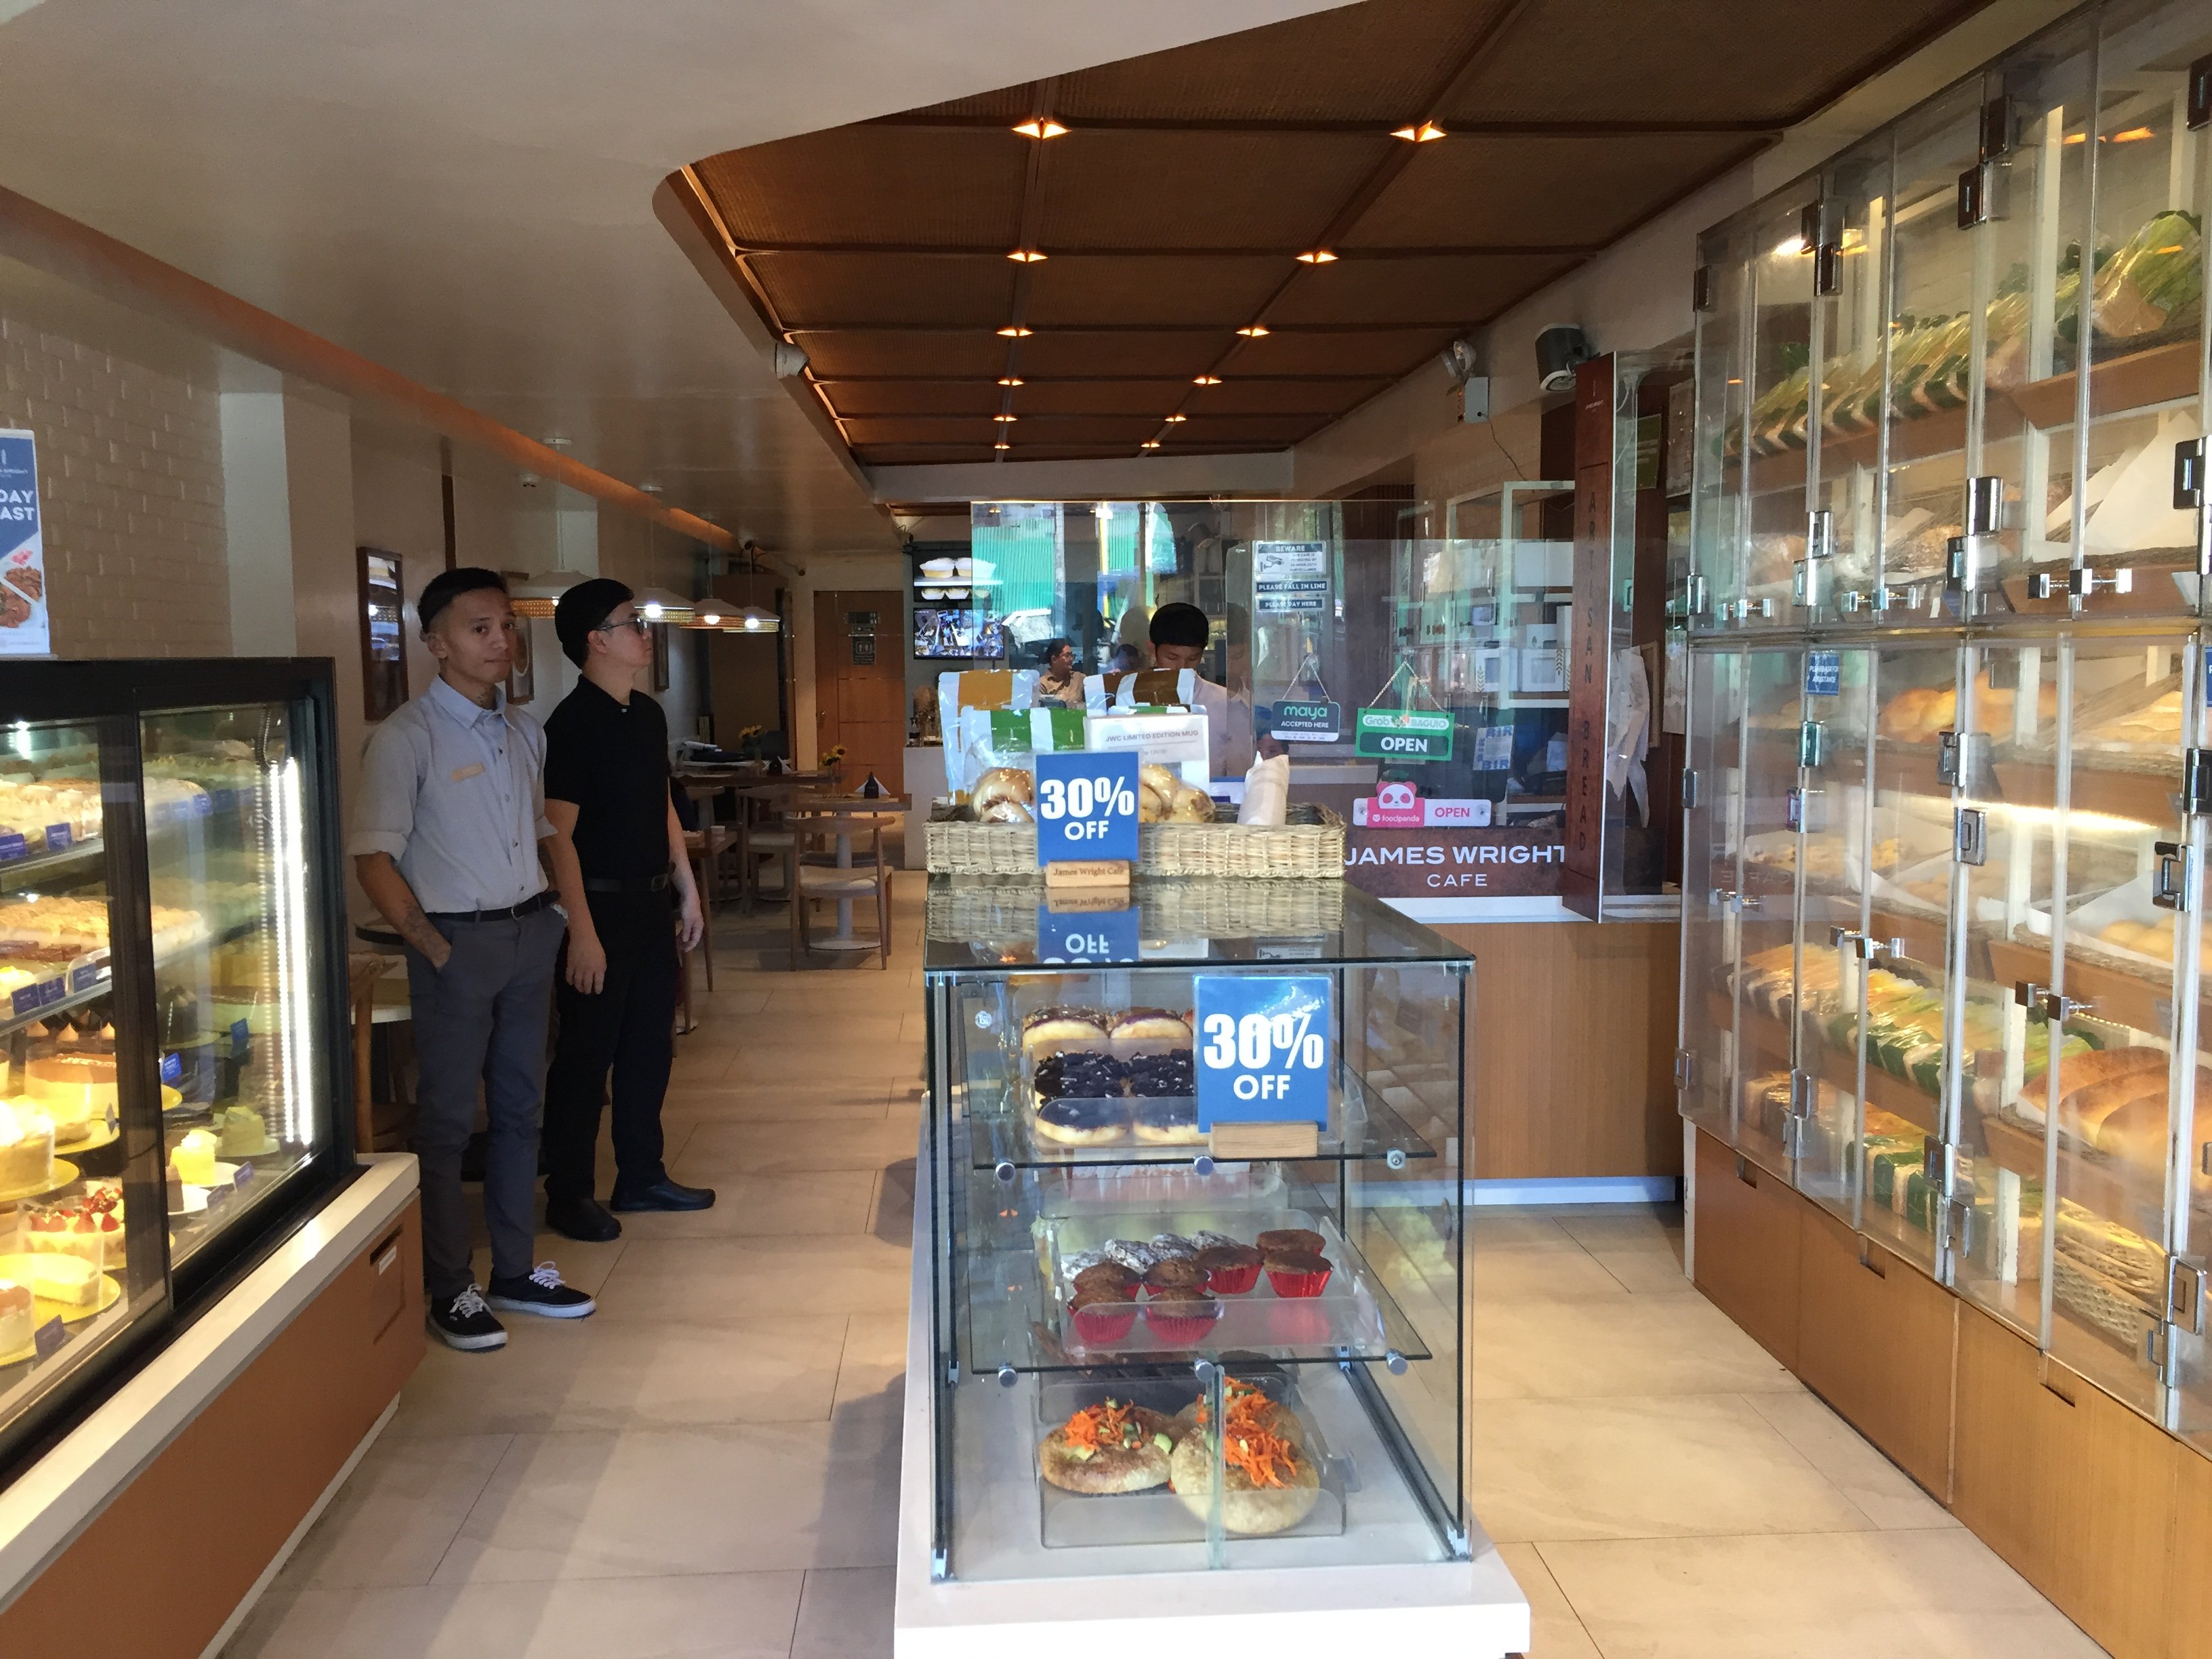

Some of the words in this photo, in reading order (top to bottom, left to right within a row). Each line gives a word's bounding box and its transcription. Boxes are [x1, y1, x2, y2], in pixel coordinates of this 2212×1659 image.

[1284, 705, 1328, 720] maya
[1365, 716, 1390, 726] Grab
[1411, 720, 1446, 729] BAGUIO
[1380, 736, 1428, 752] OPEN
[1040, 776, 1135, 819] 30%
[1382, 814, 1420, 823] foodpanda
[1434, 807, 1470, 818] OPEN
[1064, 820, 1109, 840] OFF
[1345, 846, 1446, 865] JAMES
[1452, 845, 1565, 865] WRIGHT
[1053, 868, 1078, 876] James
[1079, 867, 1106, 877] Wright
[1427, 873, 1488, 888] CAFE
[1203, 1013, 1324, 1069] 30%
[1233, 1074, 1291, 1100] OFF
